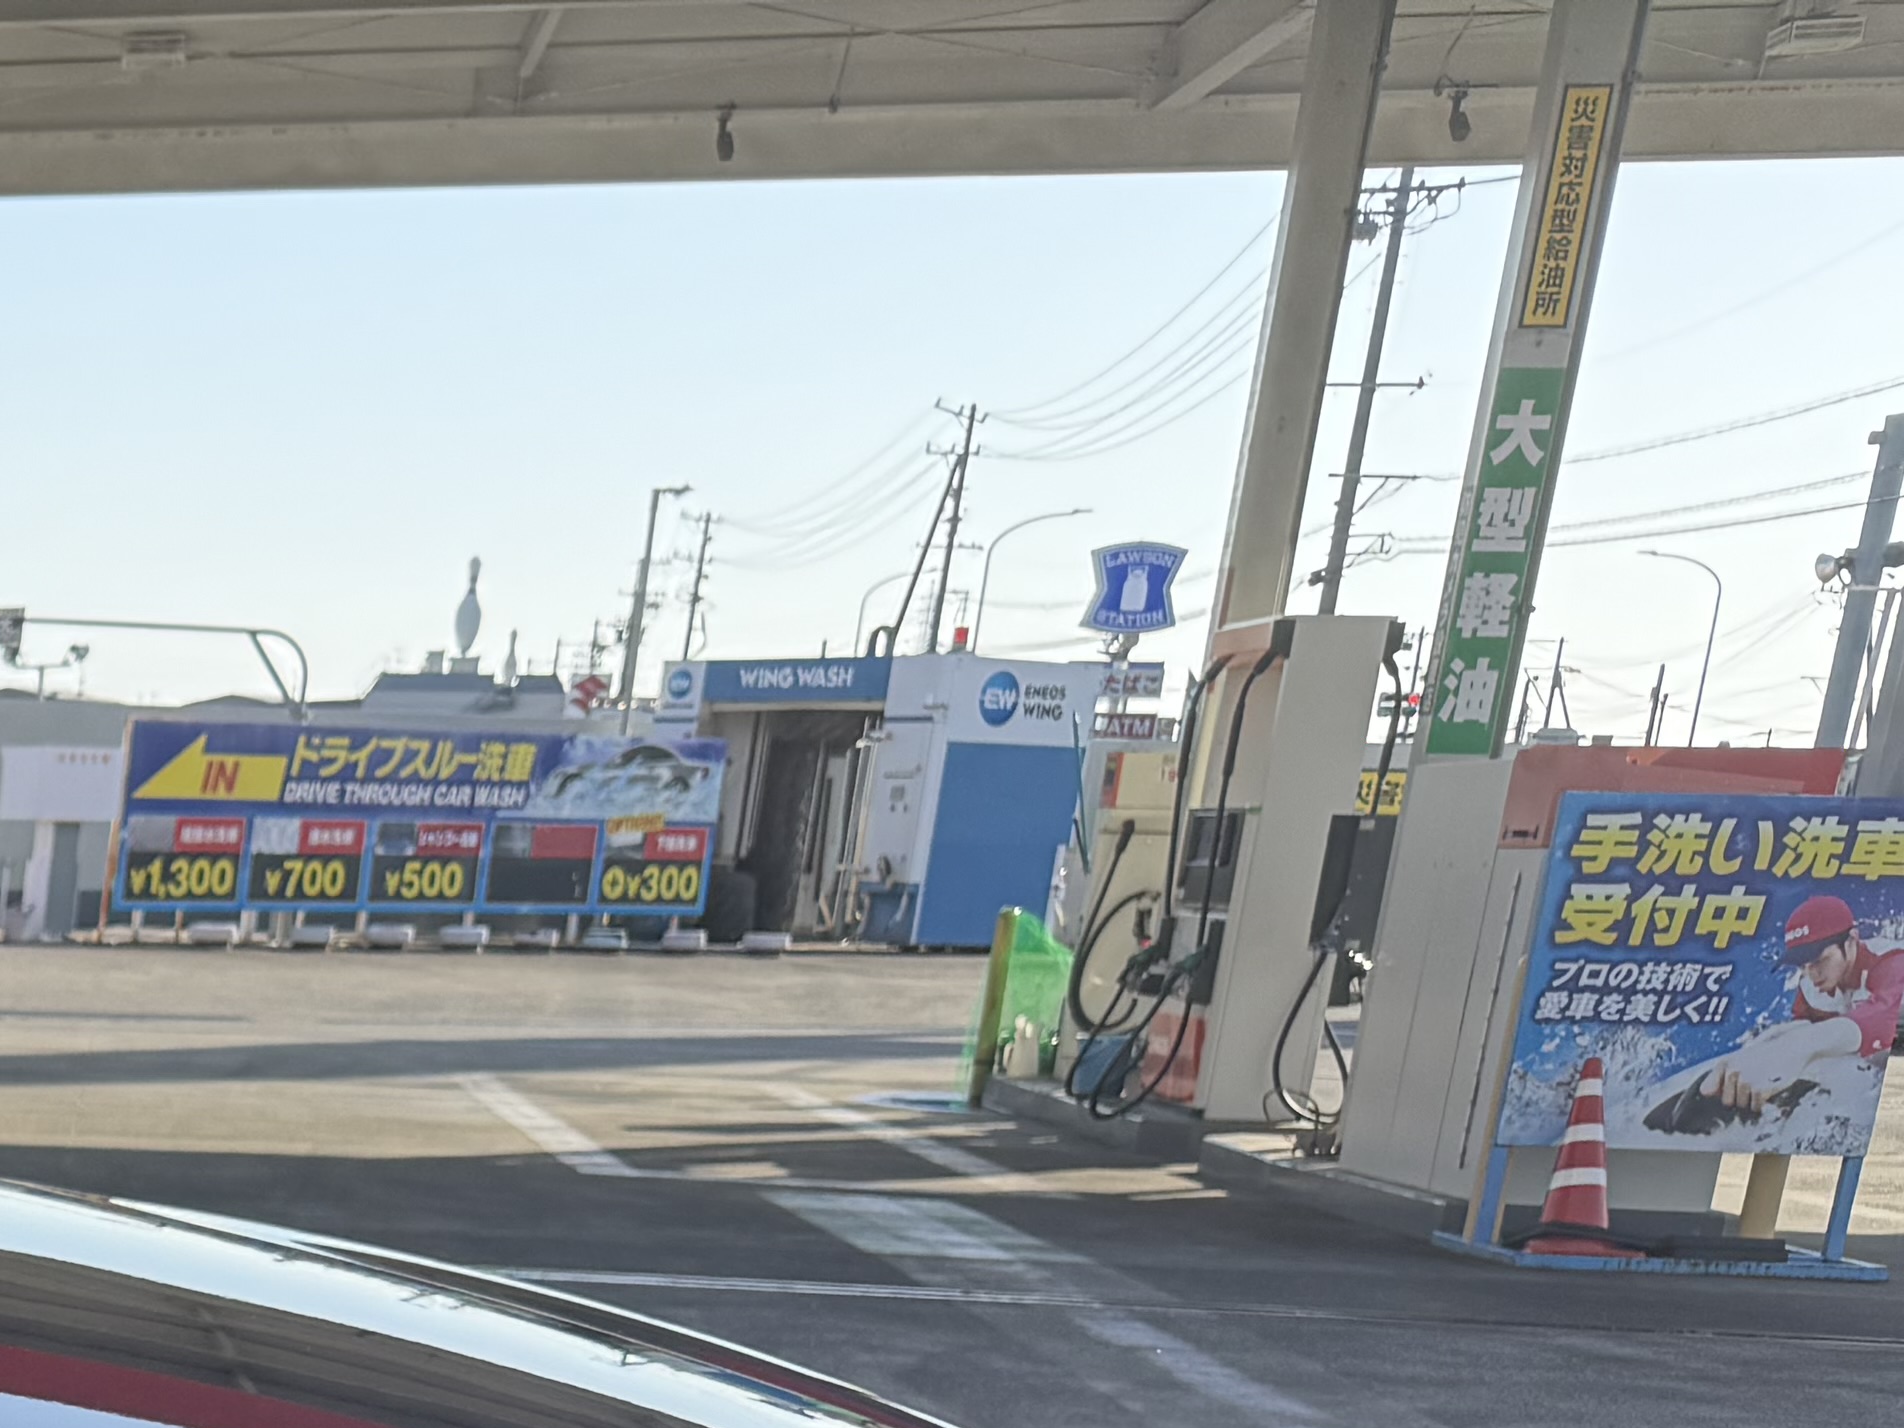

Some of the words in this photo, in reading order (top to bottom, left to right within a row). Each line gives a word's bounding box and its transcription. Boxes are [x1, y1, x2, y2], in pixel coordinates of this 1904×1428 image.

[1531, 95, 1599, 318] 災害対応型給油所
[1106, 550, 1176, 568] LAWSON
[1439, 400, 1553, 724] 大型軽油
[1096, 610, 1165, 628] STATION
[739, 667, 793, 690] WING
[797, 665, 855, 688] WASH
[1024, 684, 1067, 702] ENEOS
[982, 691, 1018, 712] EW
[1024, 702, 1064, 722] WING
[1107, 718, 1152, 737] ATM
[290, 733, 538, 781] ドライブスルー洗車
[201, 760, 240, 794] IN
[283, 780, 341, 803] DRIVE
[344, 782, 432, 804] THROUGH
[433, 785, 472, 806] CAR
[474, 785, 527, 808] WASH
[1570, 812, 1904, 880] 手洗い洗車
[130, 858, 235, 899] ¥1,300
[265, 859, 346, 898] ¥700
[385, 860, 464, 899] ¥500
[1554, 883, 1767, 949] 受付中
[1551, 959, 1733, 991] プロの技術で
